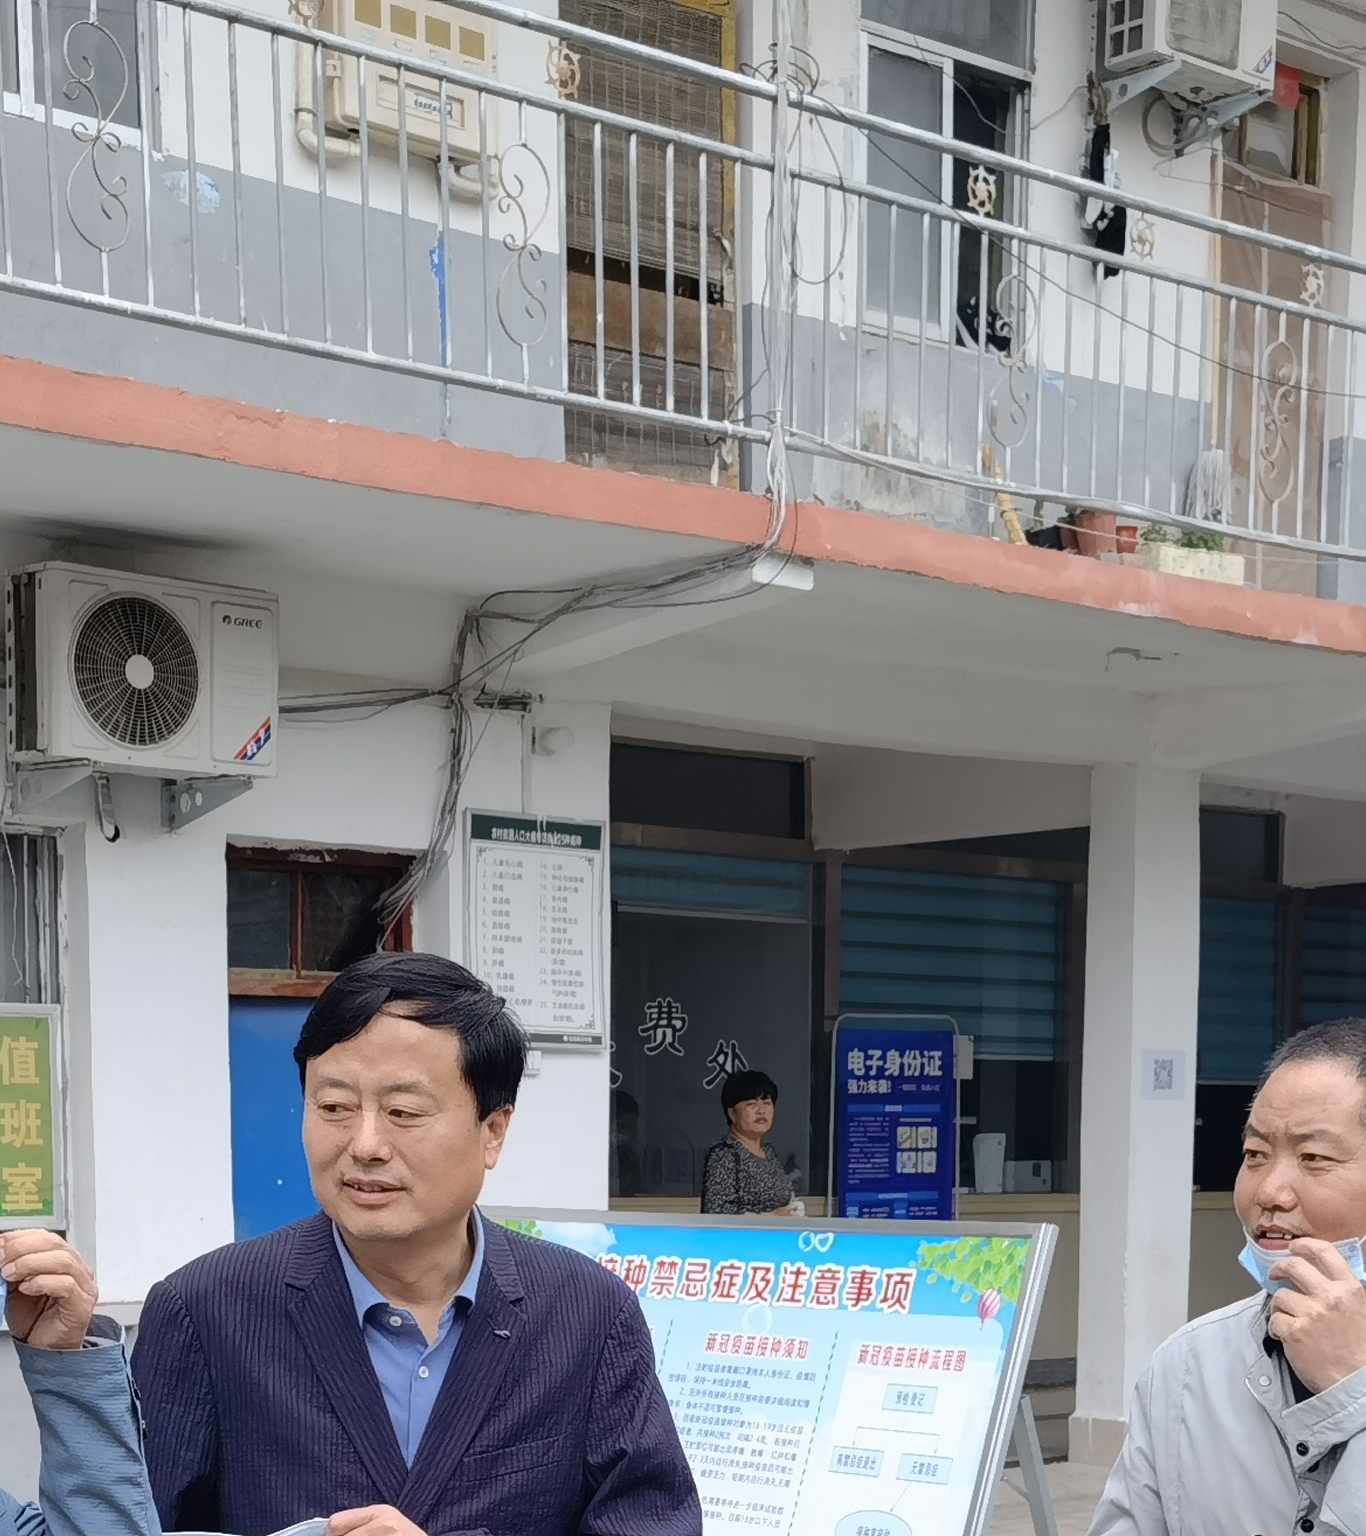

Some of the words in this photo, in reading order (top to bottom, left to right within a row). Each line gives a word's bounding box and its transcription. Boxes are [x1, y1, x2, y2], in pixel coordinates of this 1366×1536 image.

[233, 617, 263, 629] GREE
[847, 1047, 943, 1077] 电子身份证
[705, 1332, 809, 1360] 新冠疫苗接种须知
[857, 1344, 967, 1372] 新冠疫苗接种流程图
[910, 1461, 940, 1477] 无禁忌症
